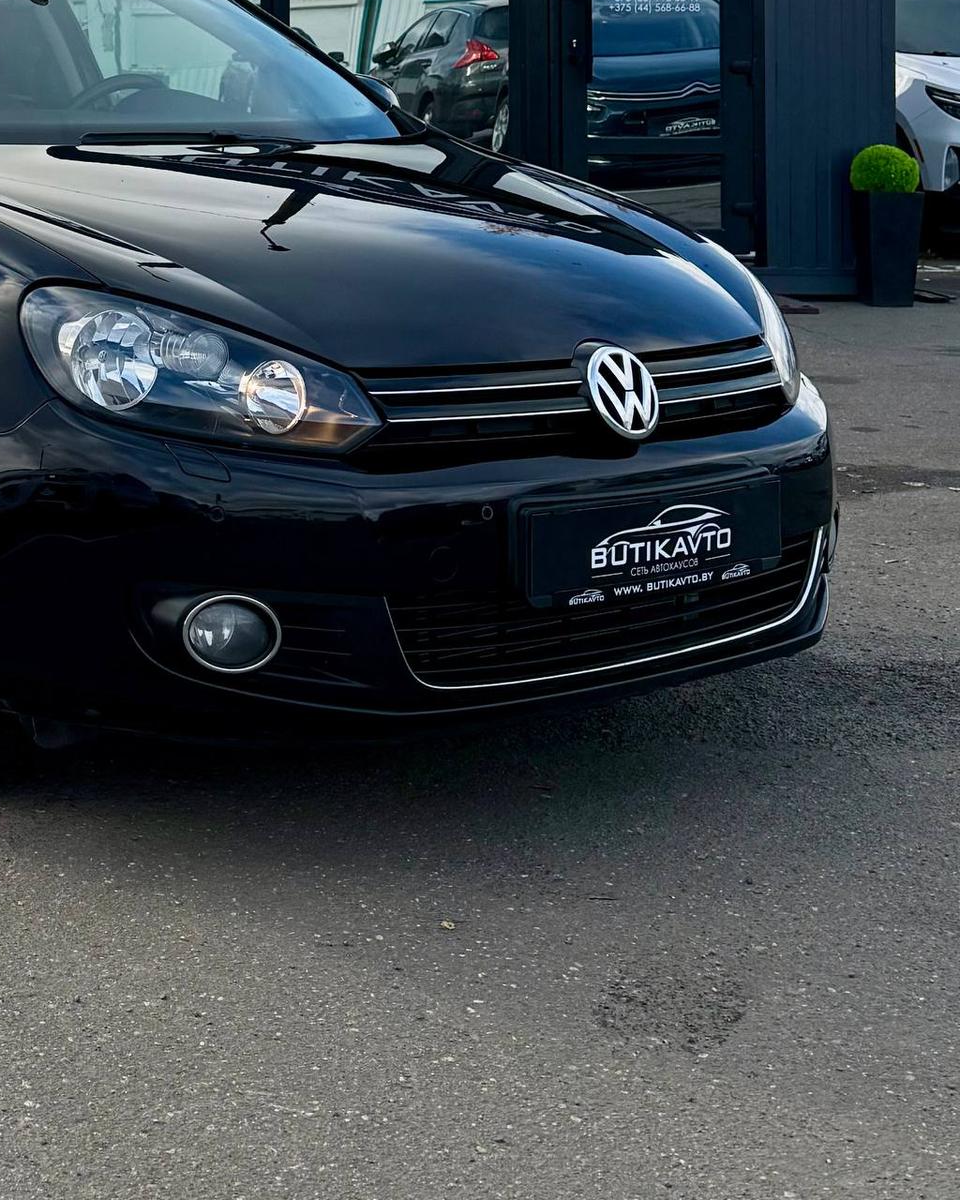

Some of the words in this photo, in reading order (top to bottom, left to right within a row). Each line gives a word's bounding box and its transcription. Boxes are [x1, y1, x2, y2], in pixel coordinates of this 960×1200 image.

[608, 3, 632, 12] +375
[634, 3, 652, 14] (44)
[655, 3, 700, 13] 568-66-88
[591, 528, 731, 569] BUTIKAVTO
[630, 566, 649, 577] СЕТЬ
[650, 558, 699, 574] АВТОХАУСОВ
[613, 585, 643, 597] WWW.
[646, 572, 714, 592] BUTIKAVTO.BY
[568, 595, 605, 606] BUTIKAVTO
